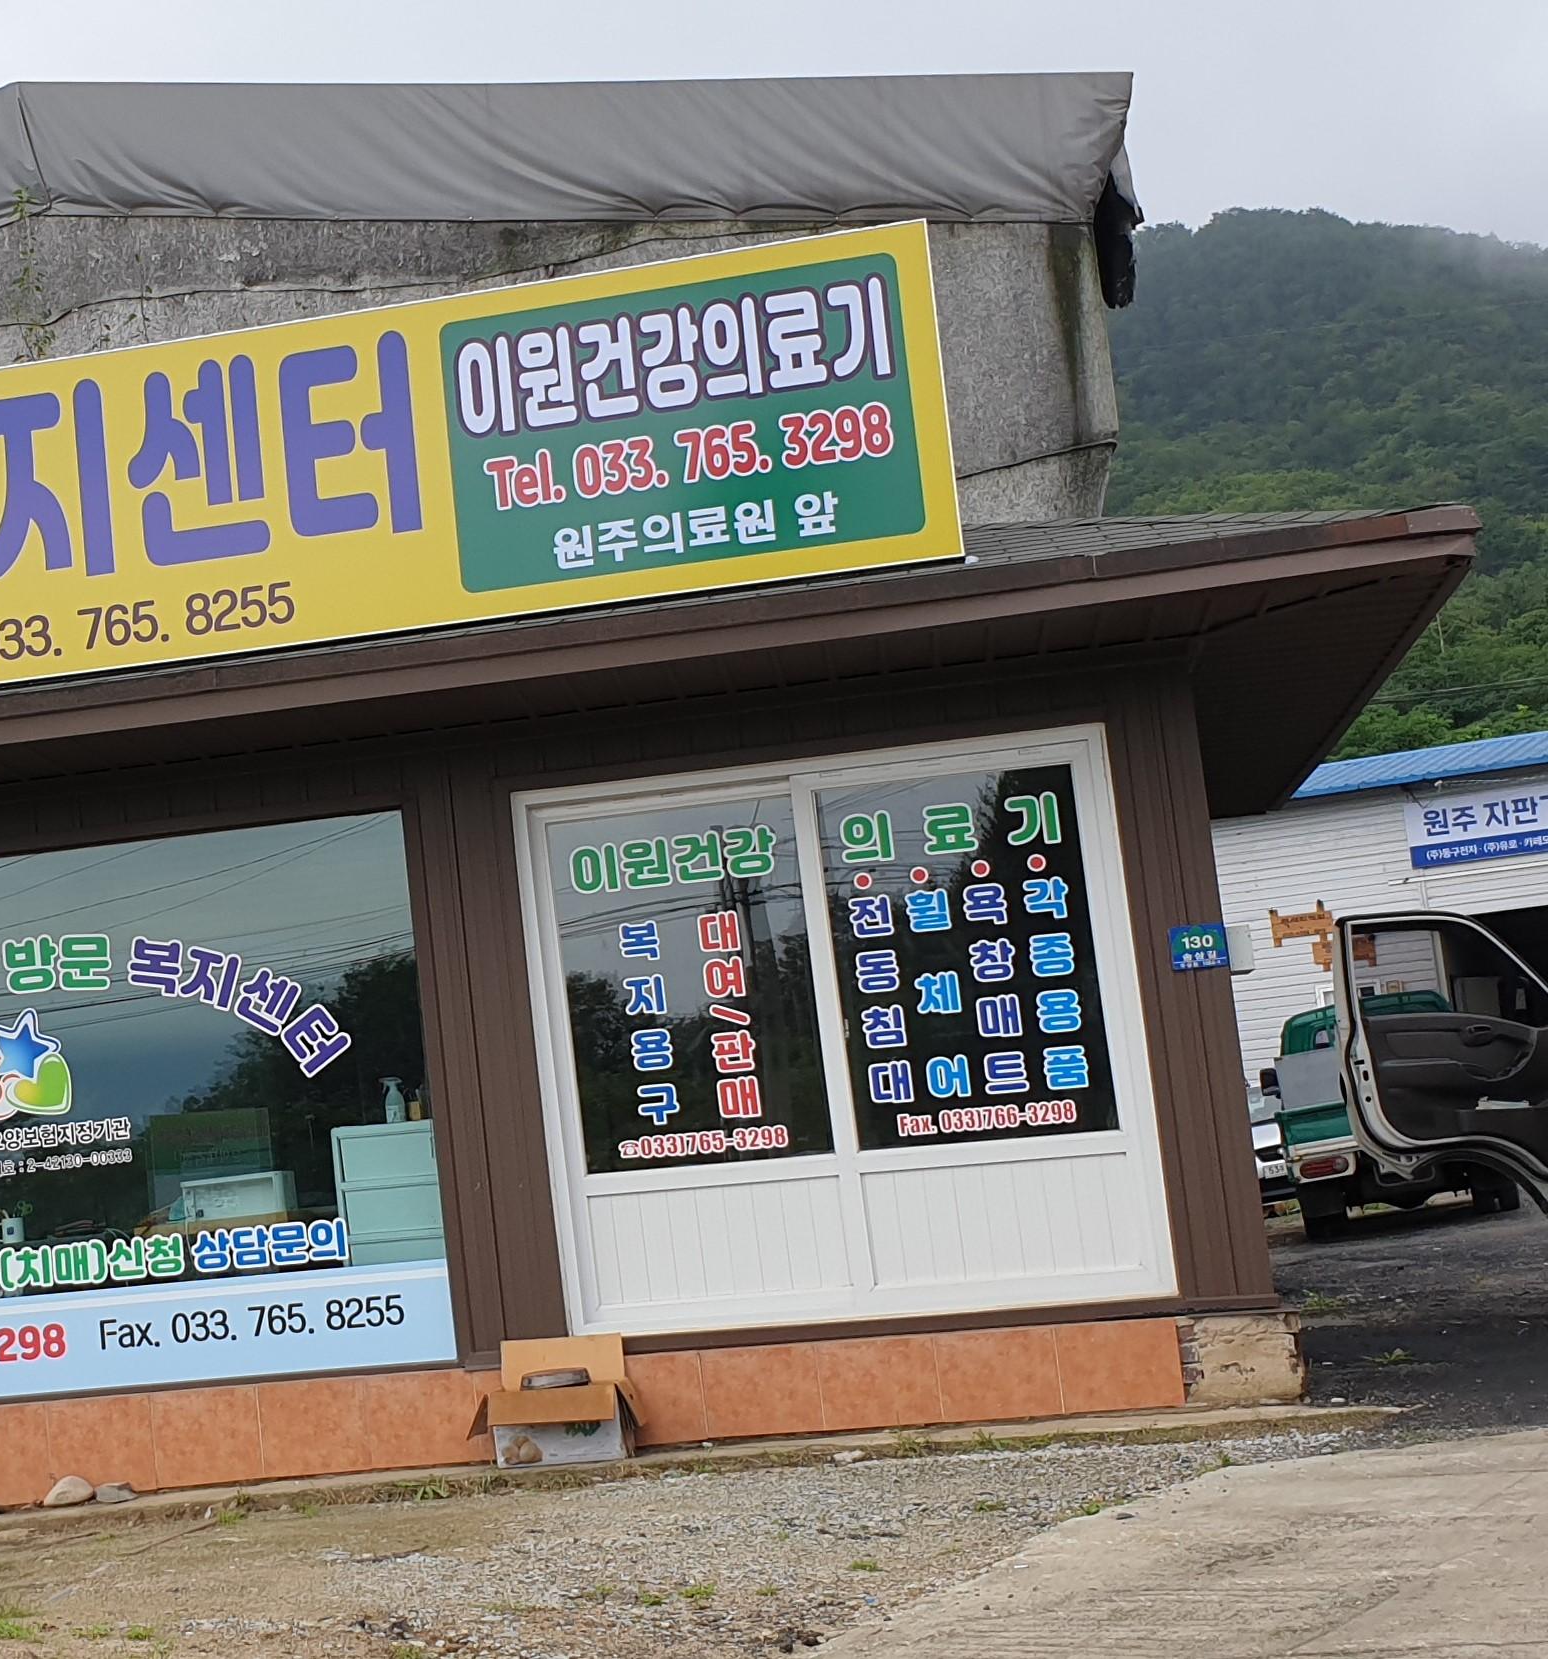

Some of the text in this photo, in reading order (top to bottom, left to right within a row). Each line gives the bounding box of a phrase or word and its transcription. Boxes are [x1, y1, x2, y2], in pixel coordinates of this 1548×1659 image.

[456, 276, 895, 438] 이원건강의료기
[483, 402, 894, 511] Tel. 033. 765. 3298
[552, 489, 839, 571] 원주의료원 앞
[77, 599, 170, 650] 765.
[185, 580, 296, 635] 8255
[569, 823, 777, 895] 이원건강
[1423, 795, 1548, 837] 원주 자판
[904, 887, 973, 1100] 휠체어
[962, 882, 1031, 1096] 욕창매트
[1022, 875, 1091, 1092] 각종용품
[1181, 934, 1214, 950] 130
[1, 932, 112, 995] 방문
[126, 936, 353, 1079] 복지센터
[618, 919, 681, 1127] 복지용구
[696, 908, 764, 1121] 대여/판매
[848, 893, 915, 1105] 전동침대
[896, 1099, 1078, 1137] Fax. 033)766-3298
[191, 1219, 351, 1273] 상담문의
[98, 1294, 406, 1353] Fax. 033. 765. 8255
